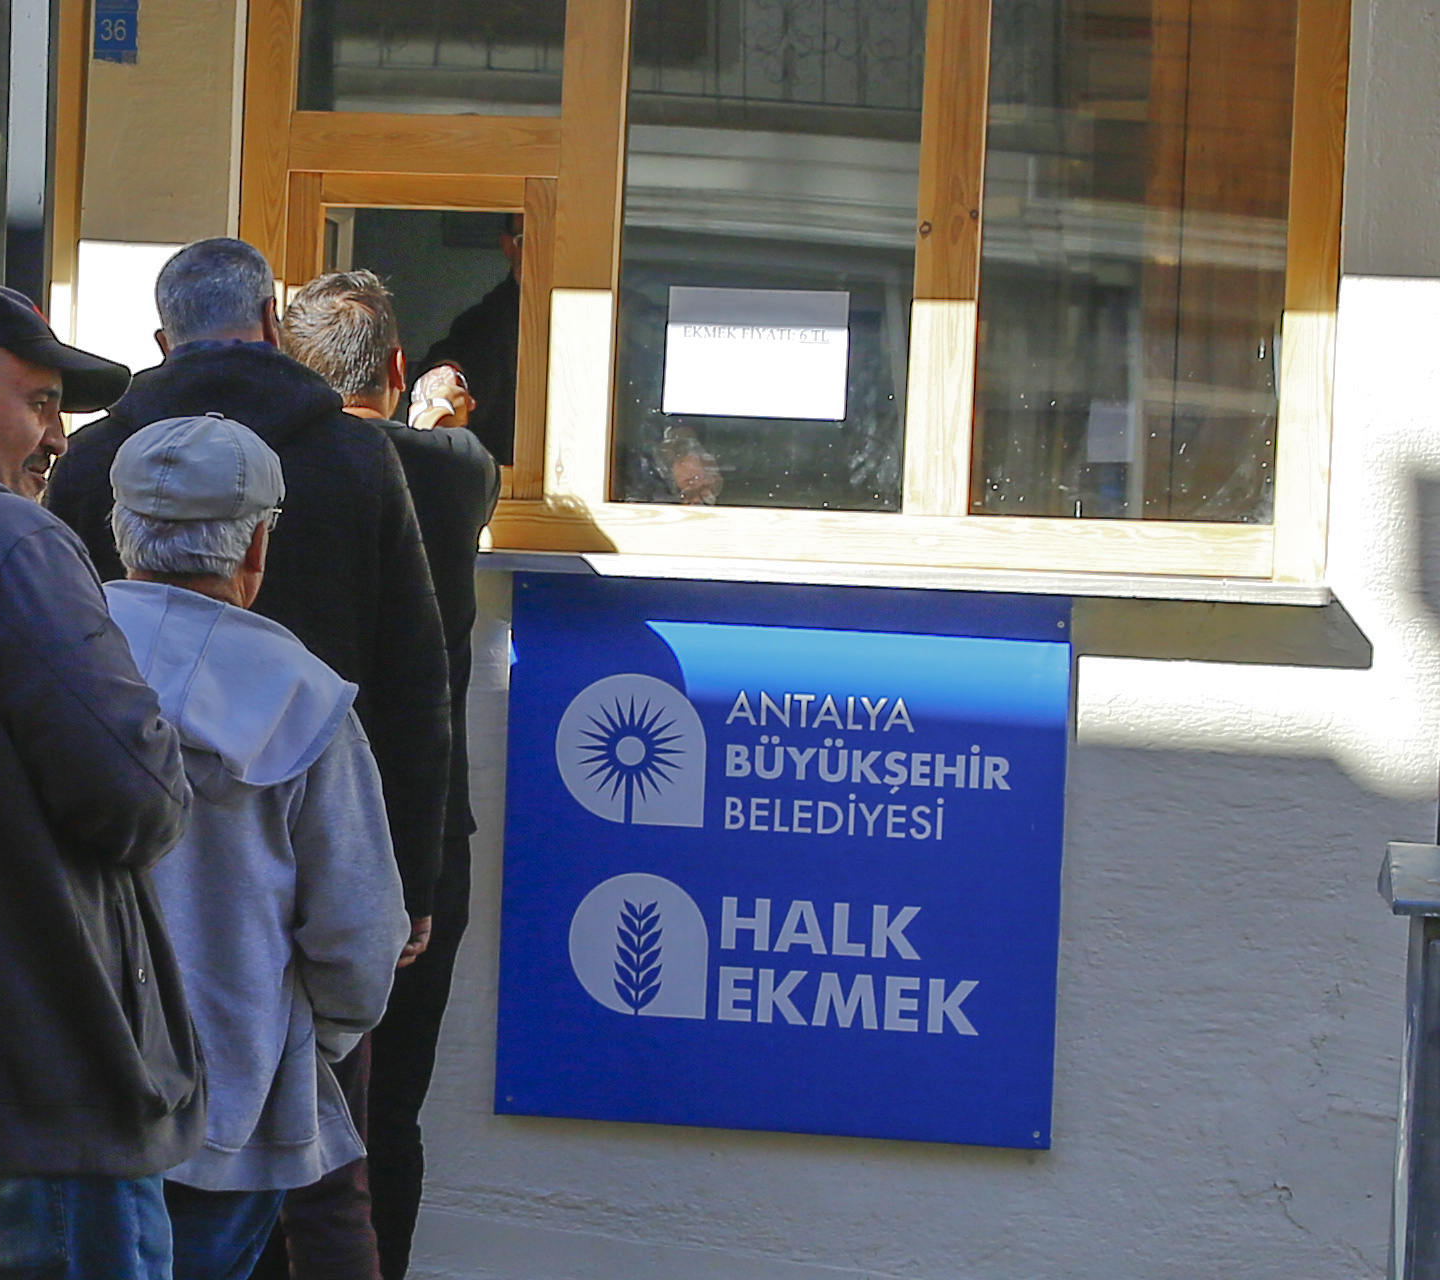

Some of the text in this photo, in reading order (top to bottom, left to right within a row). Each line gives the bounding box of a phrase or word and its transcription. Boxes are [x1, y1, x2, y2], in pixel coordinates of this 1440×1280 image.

[100, 19, 127, 41] 36
[683, 324, 737, 340] EKMEK
[800, 328, 807, 341] 6
[810, 328, 830, 343] TL
[725, 690, 915, 733] ANTALYA
[725, 735, 1011, 793] BÜYÜKŞEHİR
[723, 793, 945, 841] BELEDİYESİ
[719, 896, 923, 961] HALK
[717, 966, 980, 1037] EKMEK
